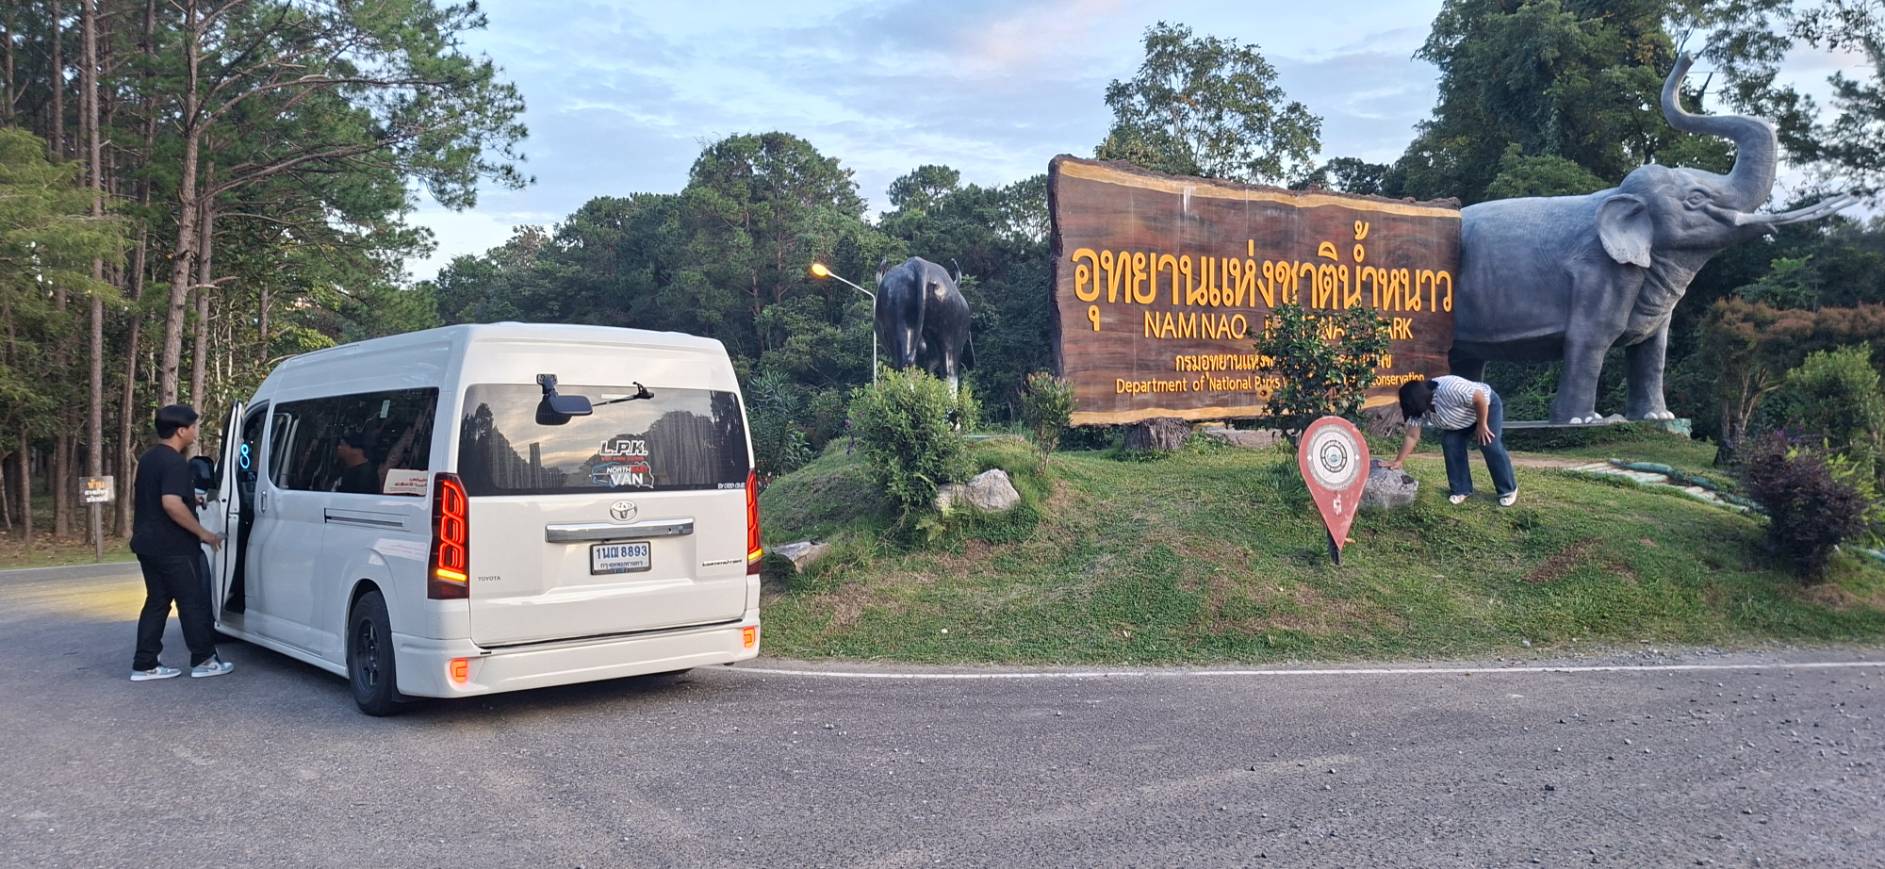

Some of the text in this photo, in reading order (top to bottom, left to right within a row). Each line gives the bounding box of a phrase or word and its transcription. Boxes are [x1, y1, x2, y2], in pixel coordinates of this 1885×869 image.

[1072, 219, 1453, 332] อุทยานแห่งชาติน้ำหนาว
[1144, 310, 1197, 339] NAM
[1201, 312, 1248, 340] NAO
[1116, 377, 1187, 397] Department
[1192, 375, 1206, 391] of
[1209, 375, 1252, 391] National
[611, 472, 643, 485] VAN
[621, 545, 647, 558] 8893
